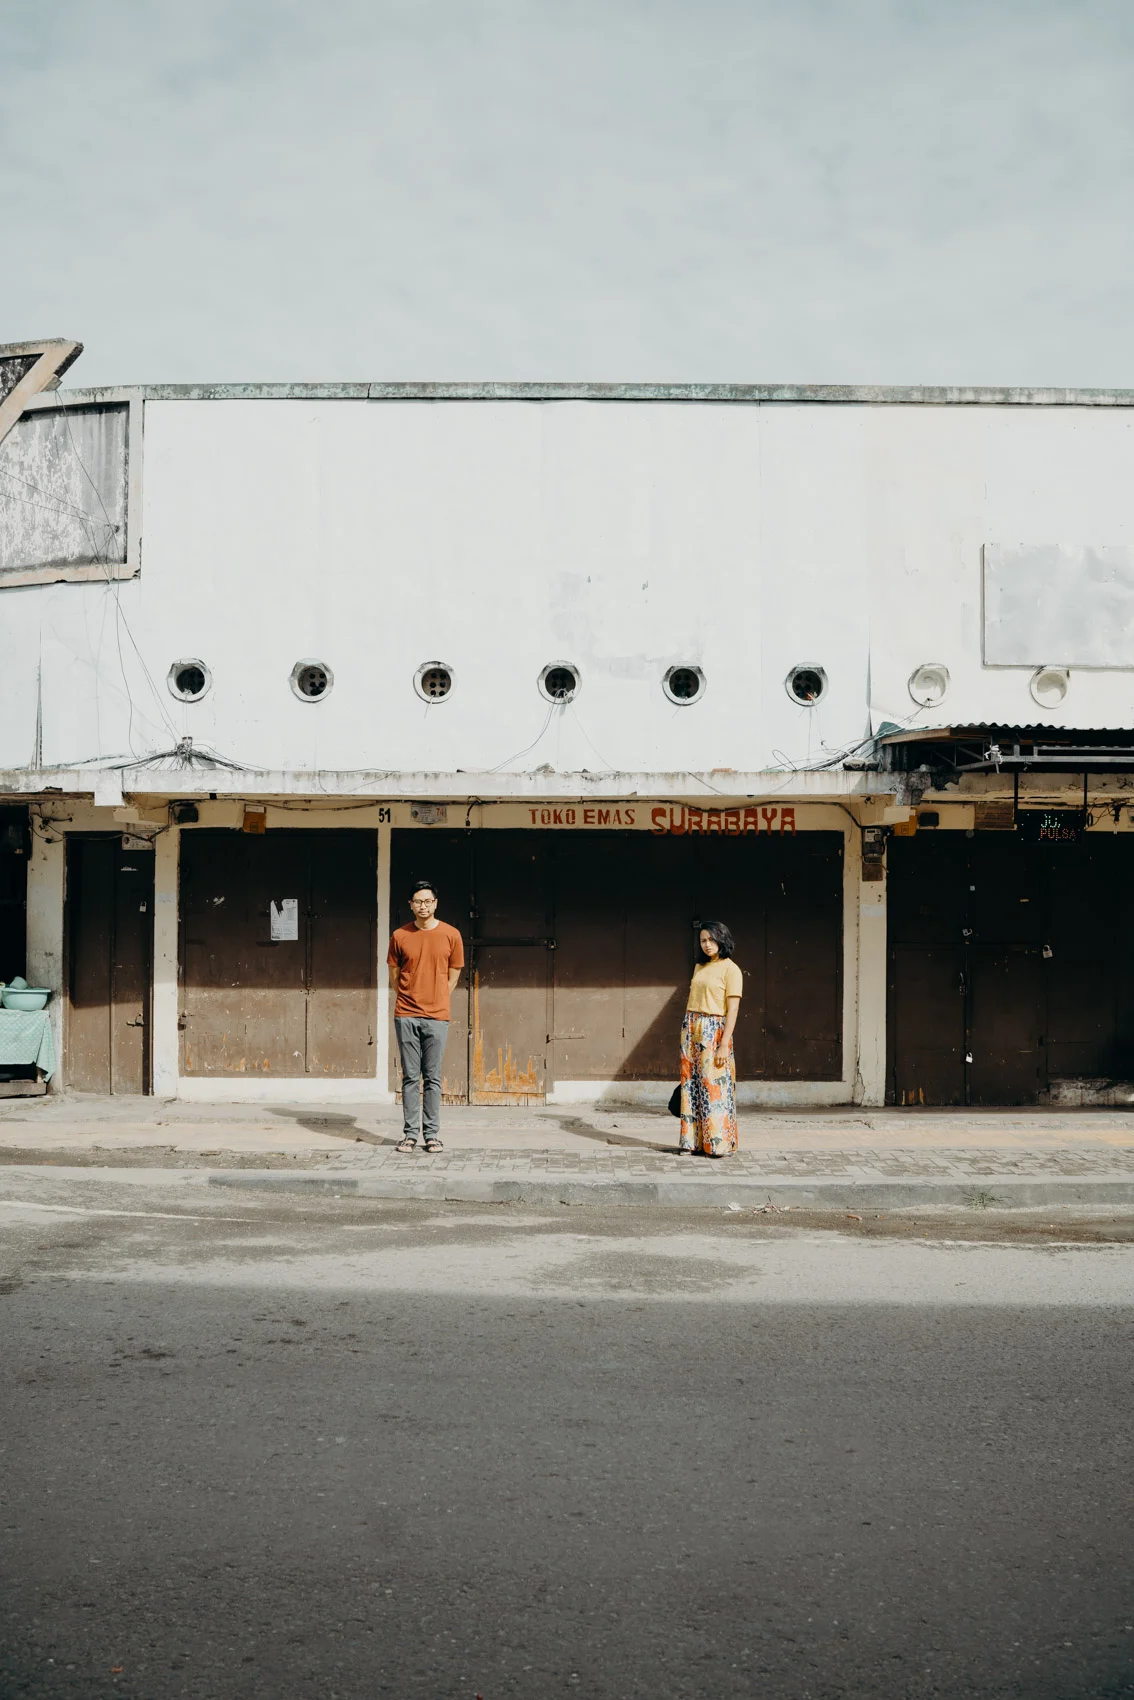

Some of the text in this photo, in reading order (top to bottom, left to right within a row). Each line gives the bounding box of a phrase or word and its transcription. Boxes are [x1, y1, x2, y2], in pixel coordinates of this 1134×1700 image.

[378, 807, 391, 823] 51
[528, 806, 797, 836] TOKO EMAS SURABAYA
[1040, 828, 1077, 839] PULSA
